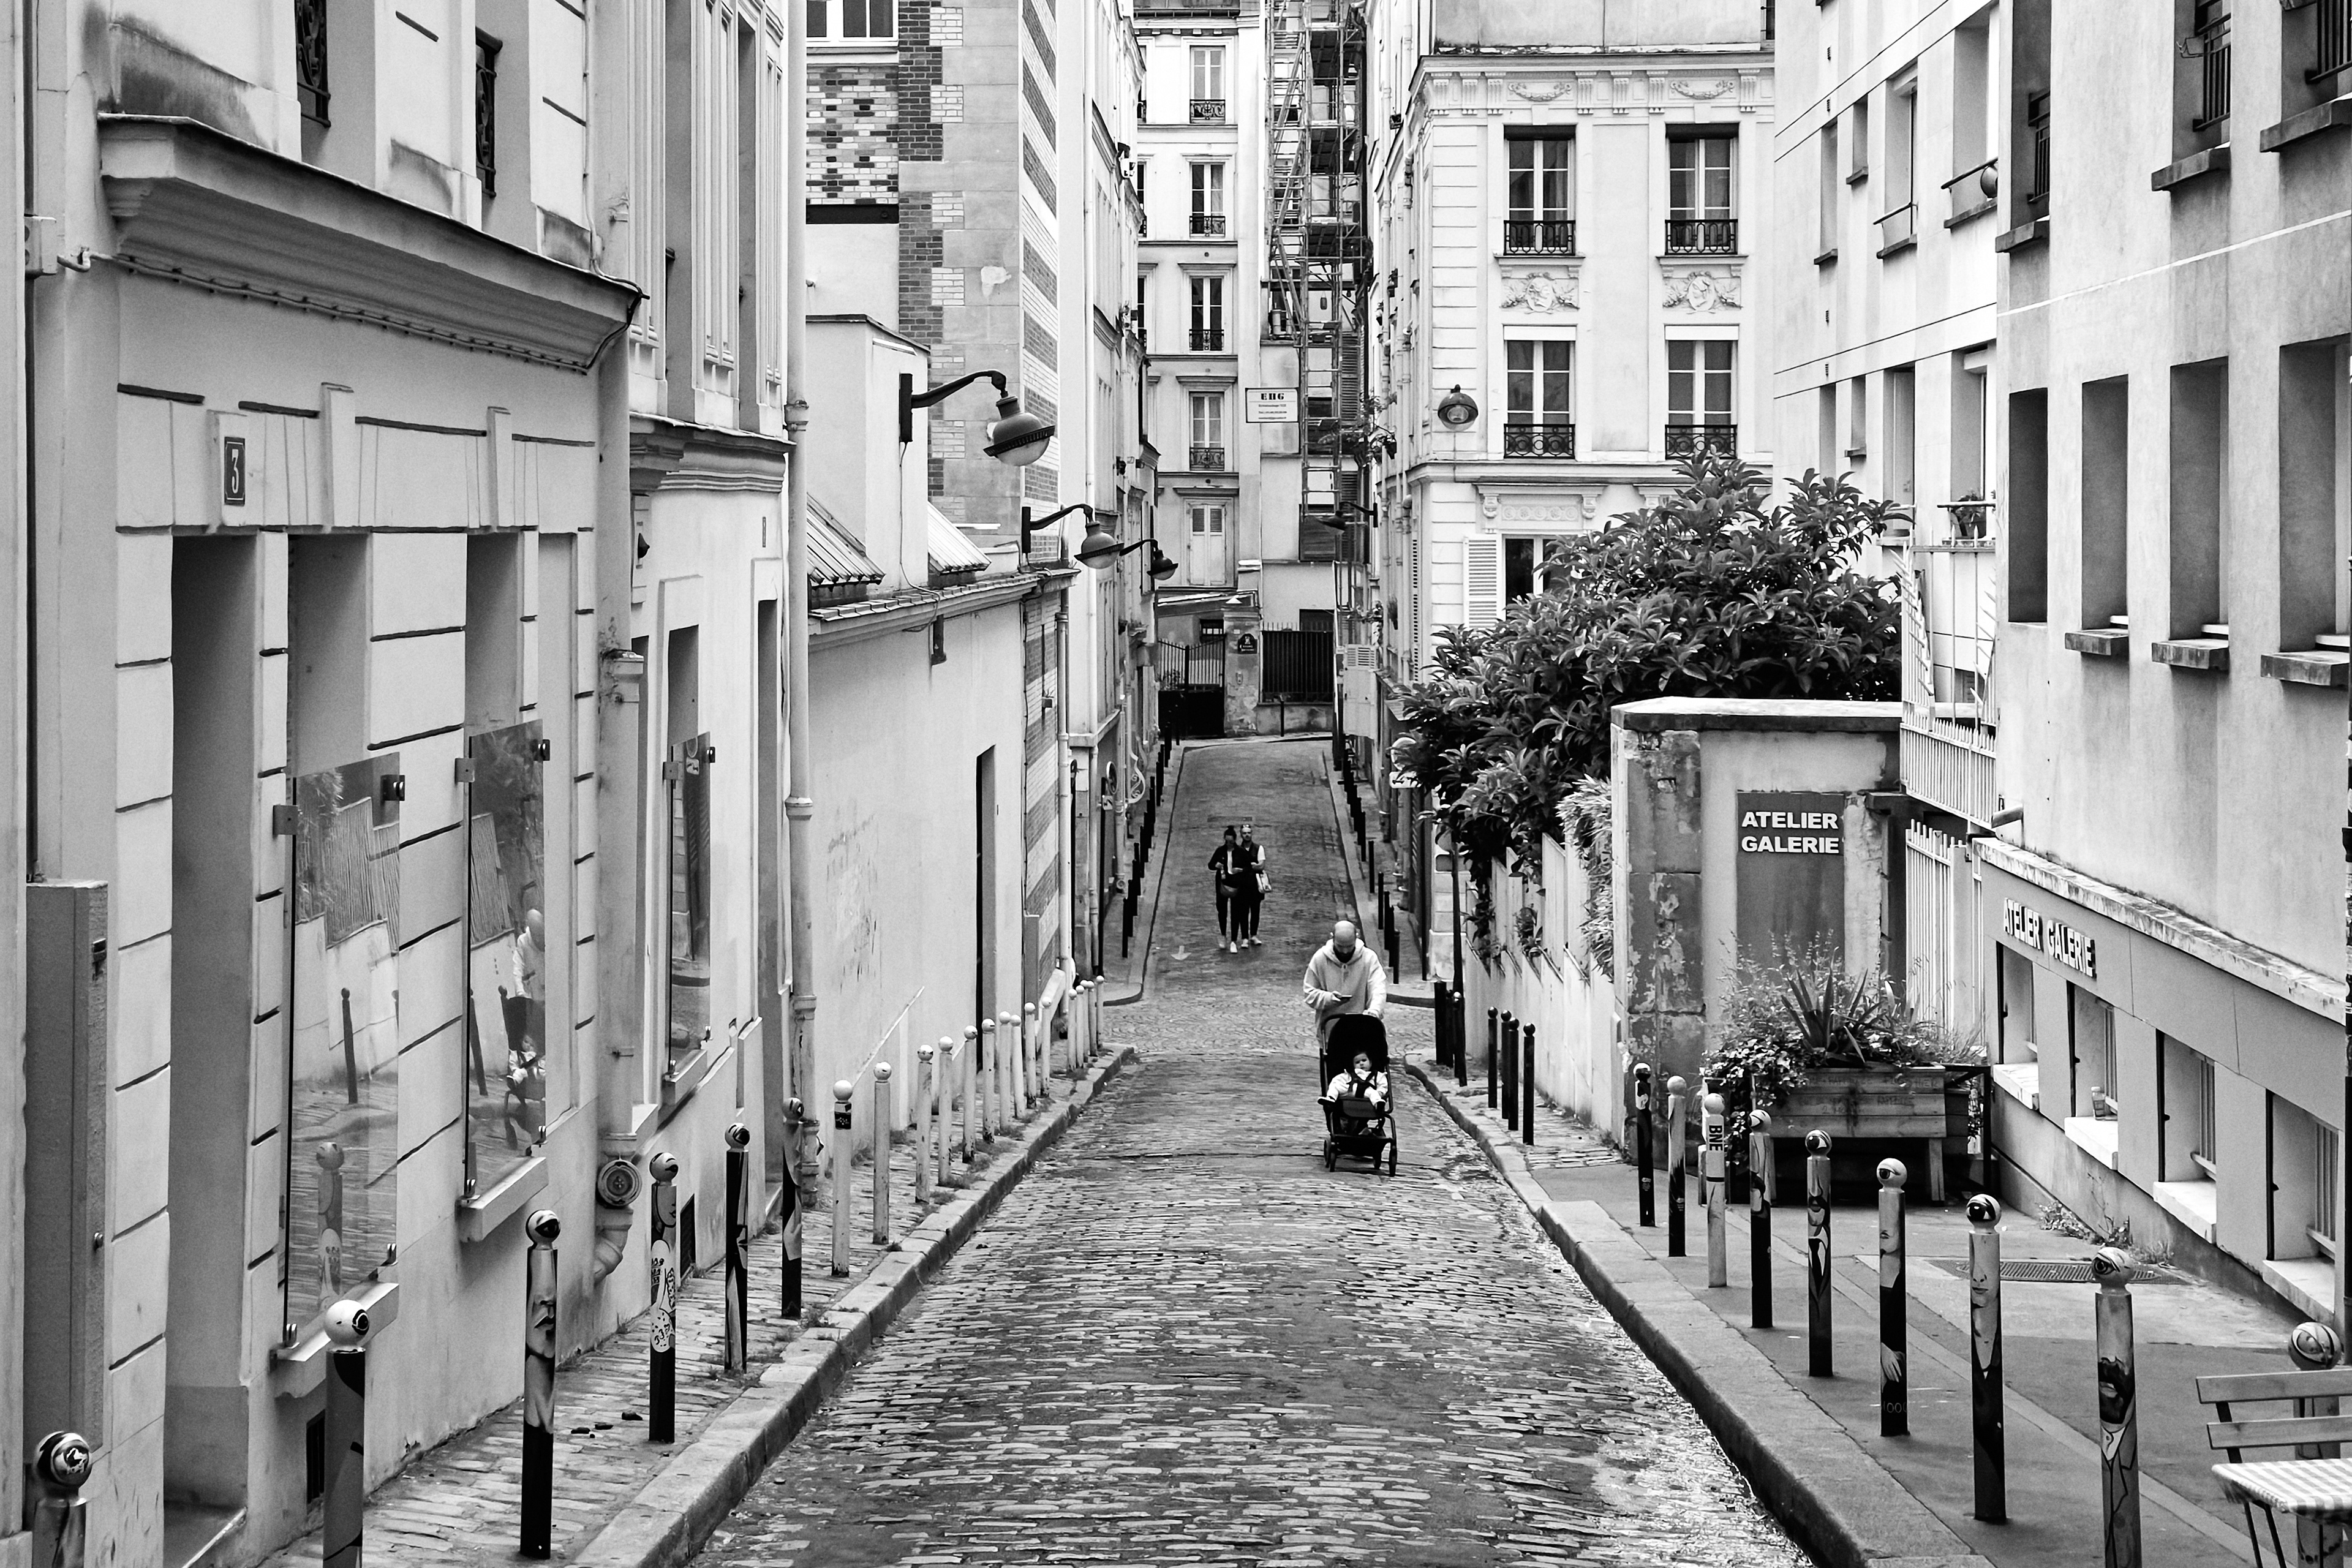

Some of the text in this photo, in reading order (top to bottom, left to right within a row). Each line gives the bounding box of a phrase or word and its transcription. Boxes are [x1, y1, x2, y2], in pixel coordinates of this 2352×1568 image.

[232, 449, 239, 494] 3
[1741, 812, 1839, 829] ATELIER
[1741, 835, 1839, 853] GALERIE
[2003, 897, 2094, 978] ATELIER GALERIE
[1709, 1125, 1722, 1151] BNE
